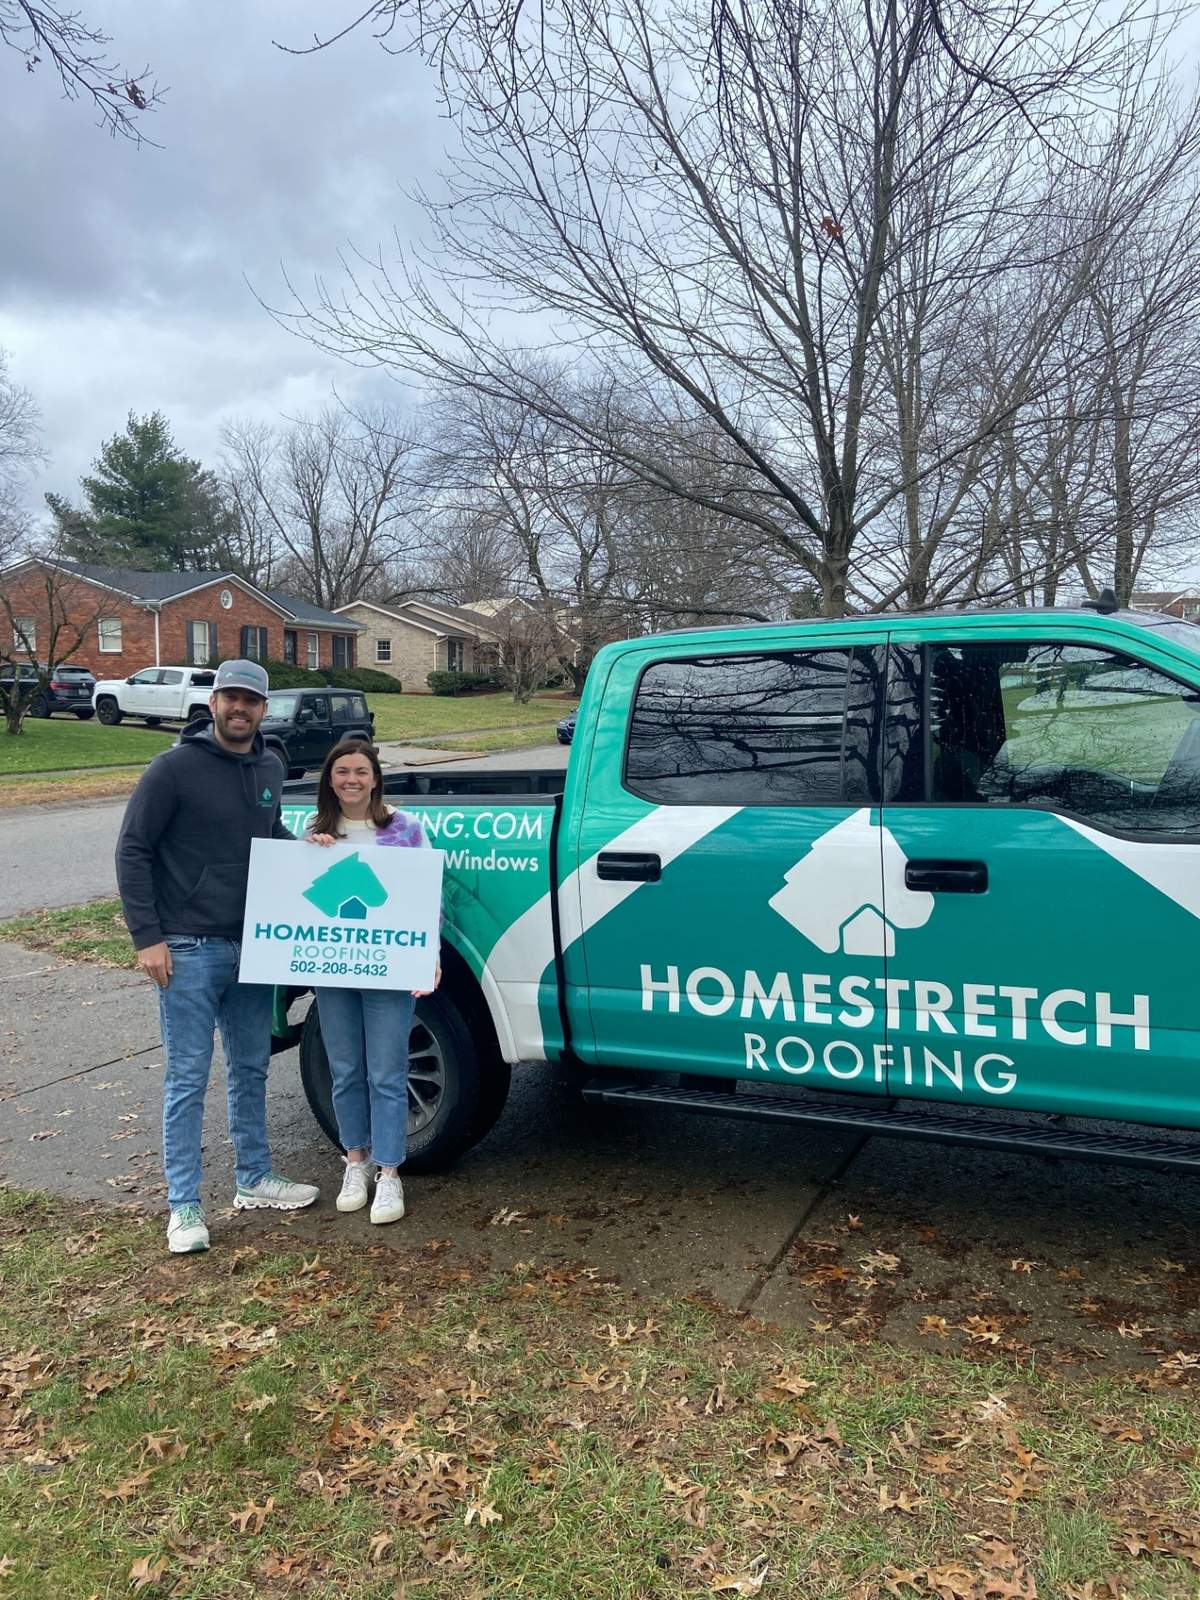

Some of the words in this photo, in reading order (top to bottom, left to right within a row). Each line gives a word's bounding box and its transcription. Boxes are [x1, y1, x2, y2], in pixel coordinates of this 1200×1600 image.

[444, 848, 539, 872] Windows
[254, 922, 427, 947] HOMESTRETCH
[292, 945, 387, 962] ROOFING
[289, 960, 388, 977] 502-208-5432
[639, 963, 1151, 1051] HOMESTRETCH
[743, 1032, 1018, 1095] ROOFING
